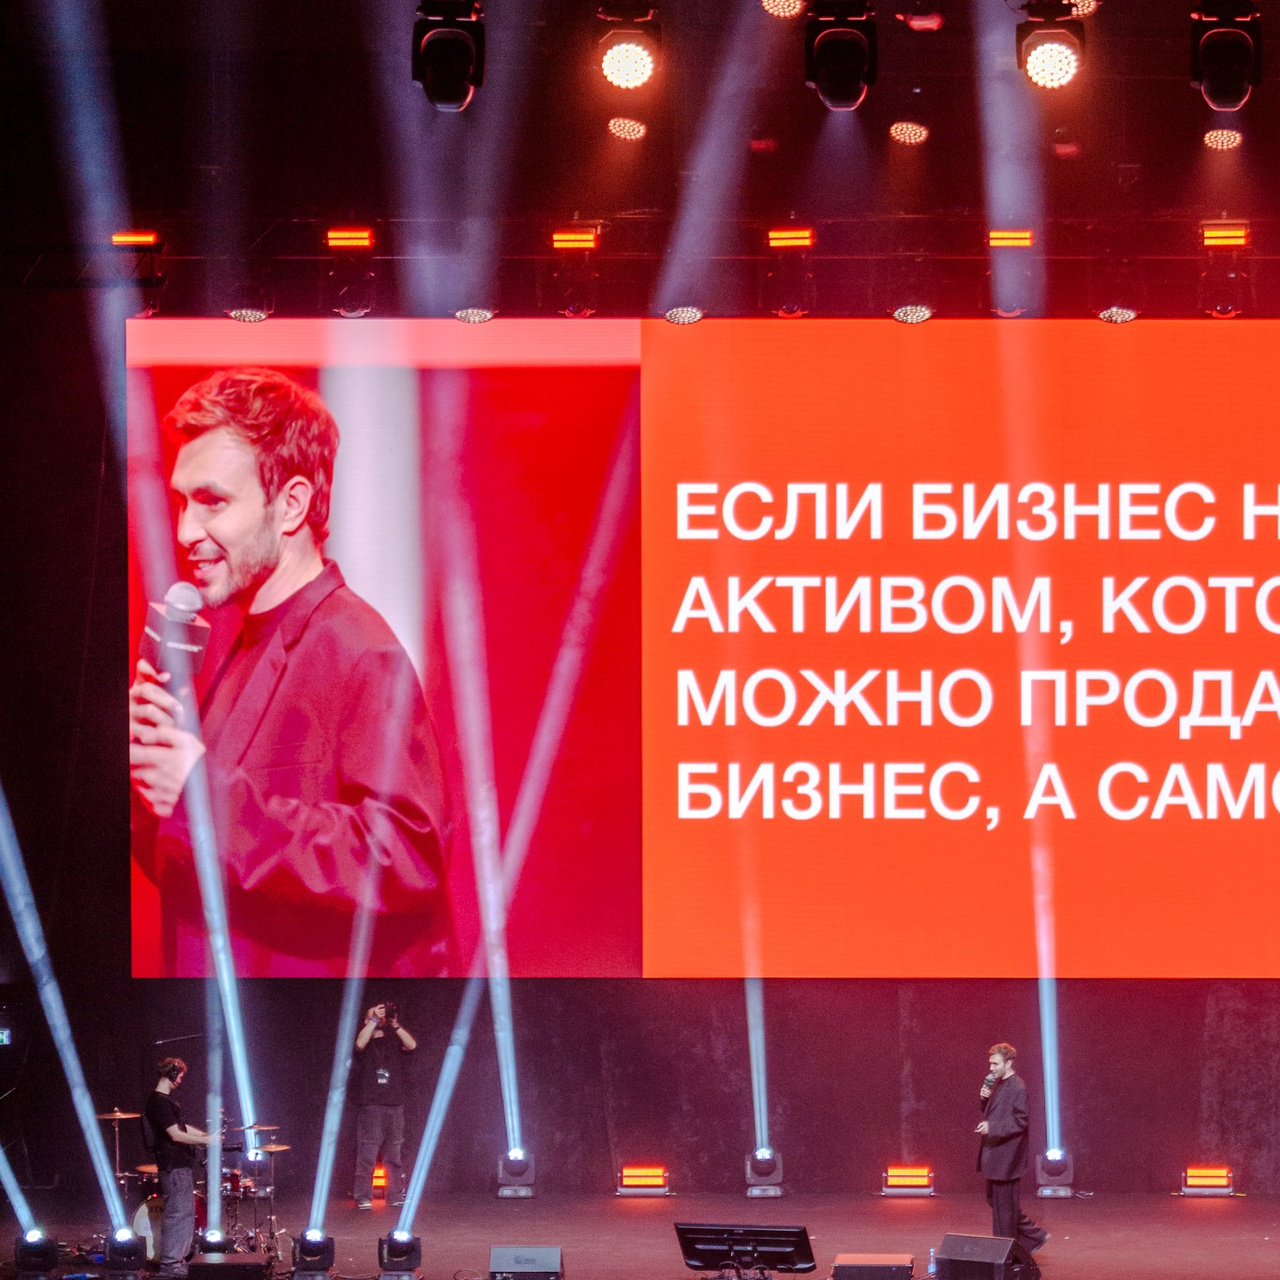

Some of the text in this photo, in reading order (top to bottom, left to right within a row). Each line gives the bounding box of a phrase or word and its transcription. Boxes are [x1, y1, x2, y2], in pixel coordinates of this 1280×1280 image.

[676, 481, 883, 541] ЕСЛИ
[912, 481, 1216, 541] БИЗНЕС
[671, 575, 1073, 645] АКТИВОМ,
[677, 668, 994, 728] МОЖНО
[677, 761, 1000, 831] БИЗНЕС,
[1023, 762, 1077, 820] А
